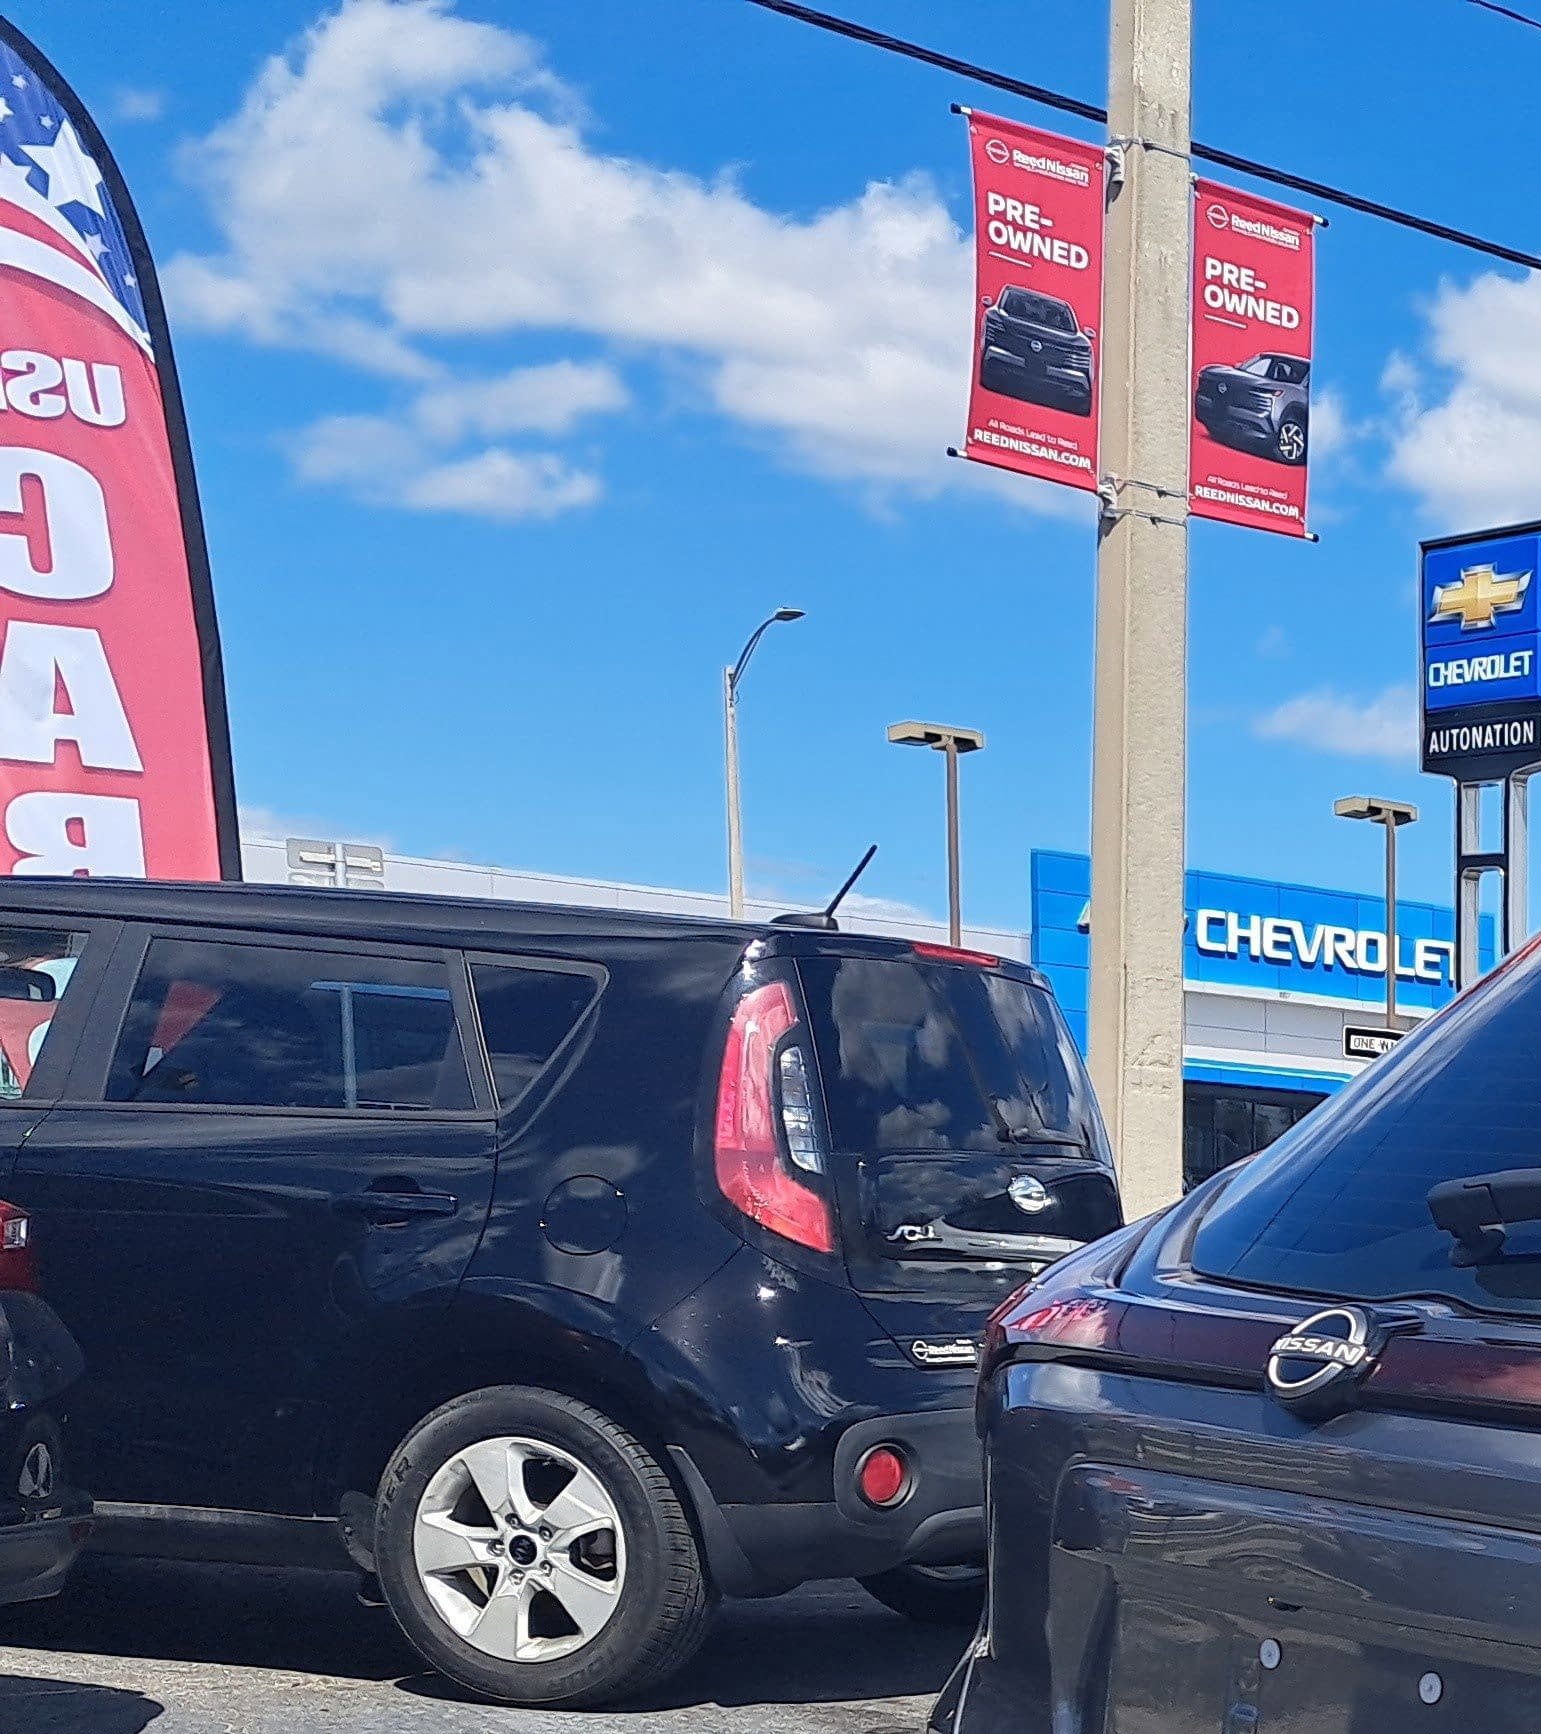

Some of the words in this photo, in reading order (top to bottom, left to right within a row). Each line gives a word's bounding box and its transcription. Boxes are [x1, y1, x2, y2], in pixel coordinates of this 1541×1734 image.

[987, 191, 1054, 230] PRE-
[987, 219, 1090, 270] OWNED
[1205, 256, 1267, 293] PRE-
[1203, 284, 1300, 329] OWNED
[973, 428, 1092, 470] REEDNISSAN.COM
[1194, 484, 1300, 519] REEDNISSAN.COM
[1428, 649, 1534, 688] CHEVROLET
[1428, 720, 1534, 755] AUTONATION
[1353, 1037, 1376, 1050] ONE
[1276, 1337, 1361, 1362] NISSAN
